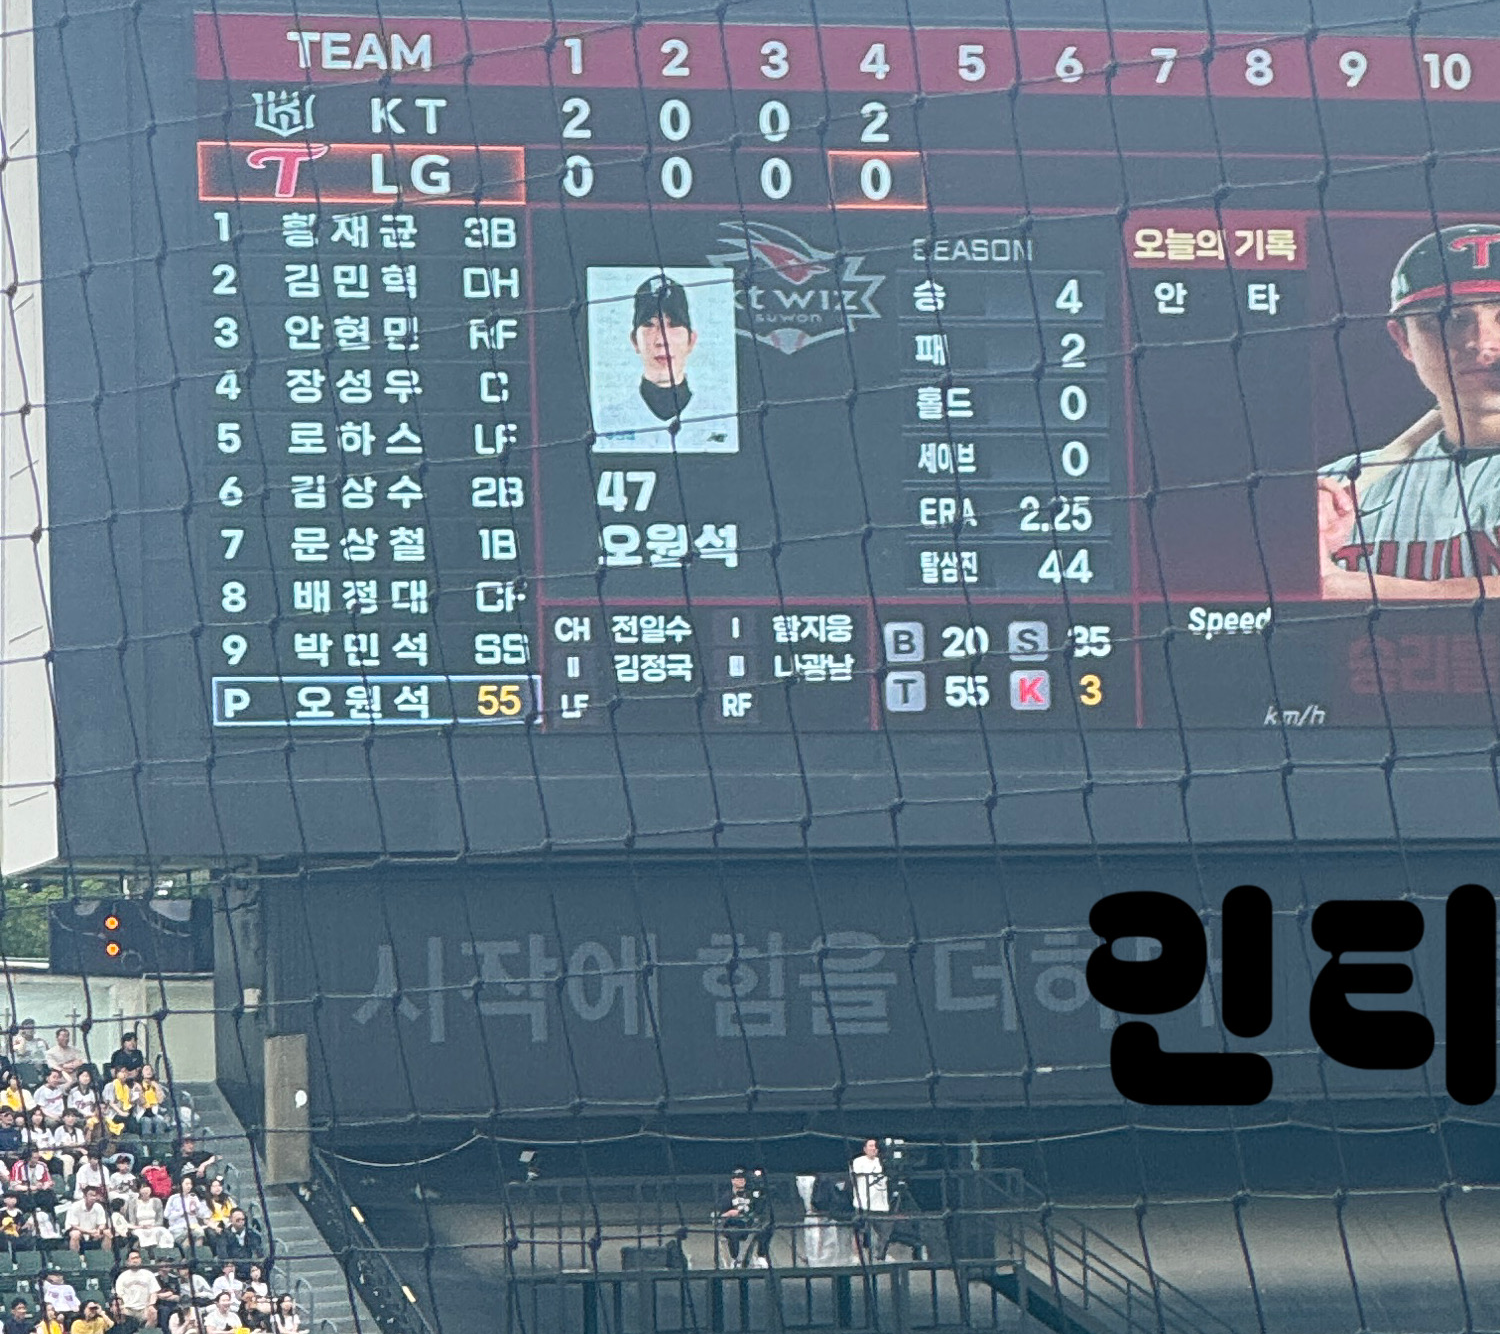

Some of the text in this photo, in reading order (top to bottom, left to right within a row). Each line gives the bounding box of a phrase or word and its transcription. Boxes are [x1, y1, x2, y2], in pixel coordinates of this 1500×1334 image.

[287, 32, 432, 70] TEAM
[565, 38, 582, 75] 1
[661, 40, 689, 76] 2
[760, 41, 789, 79] 3
[861, 43, 889, 80] 4
[958, 45, 986, 81] 5
[1056, 47, 1083, 83] 6
[1151, 48, 1177, 83] 7
[1246, 49, 1273, 86] 8
[1339, 51, 1367, 88] 9
[1423, 53, 1471, 90] 10
[372, 98, 447, 135] KT
[563, 98, 591, 139] 2
[660, 100, 691, 140] 0
[759, 100, 790, 142] 0
[861, 103, 889, 143] 2
[372, 154, 450, 194] LG
[563, 155, 593, 198] 0
[662, 156, 692, 198] 0
[761, 158, 792, 200] 0
[861, 159, 892, 201] 0
[215, 213, 230, 242] 1
[463, 218, 516, 248] 3B
[1134, 229, 1297, 262] 오늘의 기록
[913, 239, 1032, 262] SEASON
[213, 264, 519, 298] 2 김민혁 DH
[913, 280, 1083, 313] 승 4
[215, 317, 238, 348] 3
[915, 334, 1085, 367] 패 2
[216, 370, 240, 400] 4
[286, 369, 422, 403] 장성우
[917, 386, 1087, 420] 홀드 0
[218, 423, 517, 455] 5 로하스 LF
[1062, 442, 1088, 476] 0
[219, 475, 524, 508] 6 김상수 2B
[598, 471, 657, 512] 47
[920, 496, 1091, 531] ERA 2.25
[221, 527, 518, 561] 7 문상철 1B
[599, 524, 738, 567] 오원석
[1039, 549, 1092, 584] 44
[222, 581, 247, 612] 8
[555, 617, 590, 642] CH
[612, 616, 692, 643] 전일수
[1189, 607, 1272, 640] Speed
[223, 632, 528, 667] 9 박민석 SS
[943, 627, 988, 657] 20
[613, 654, 692, 682] 김정국
[225, 684, 521, 719] P 오원석 55
[561, 693, 751, 718] LF RF
[945, 675, 1101, 707] 55 3
[1264, 705, 1325, 725] km/h
[352, 931, 659, 1044] 시작에
[697, 930, 898, 1037] 힘을
